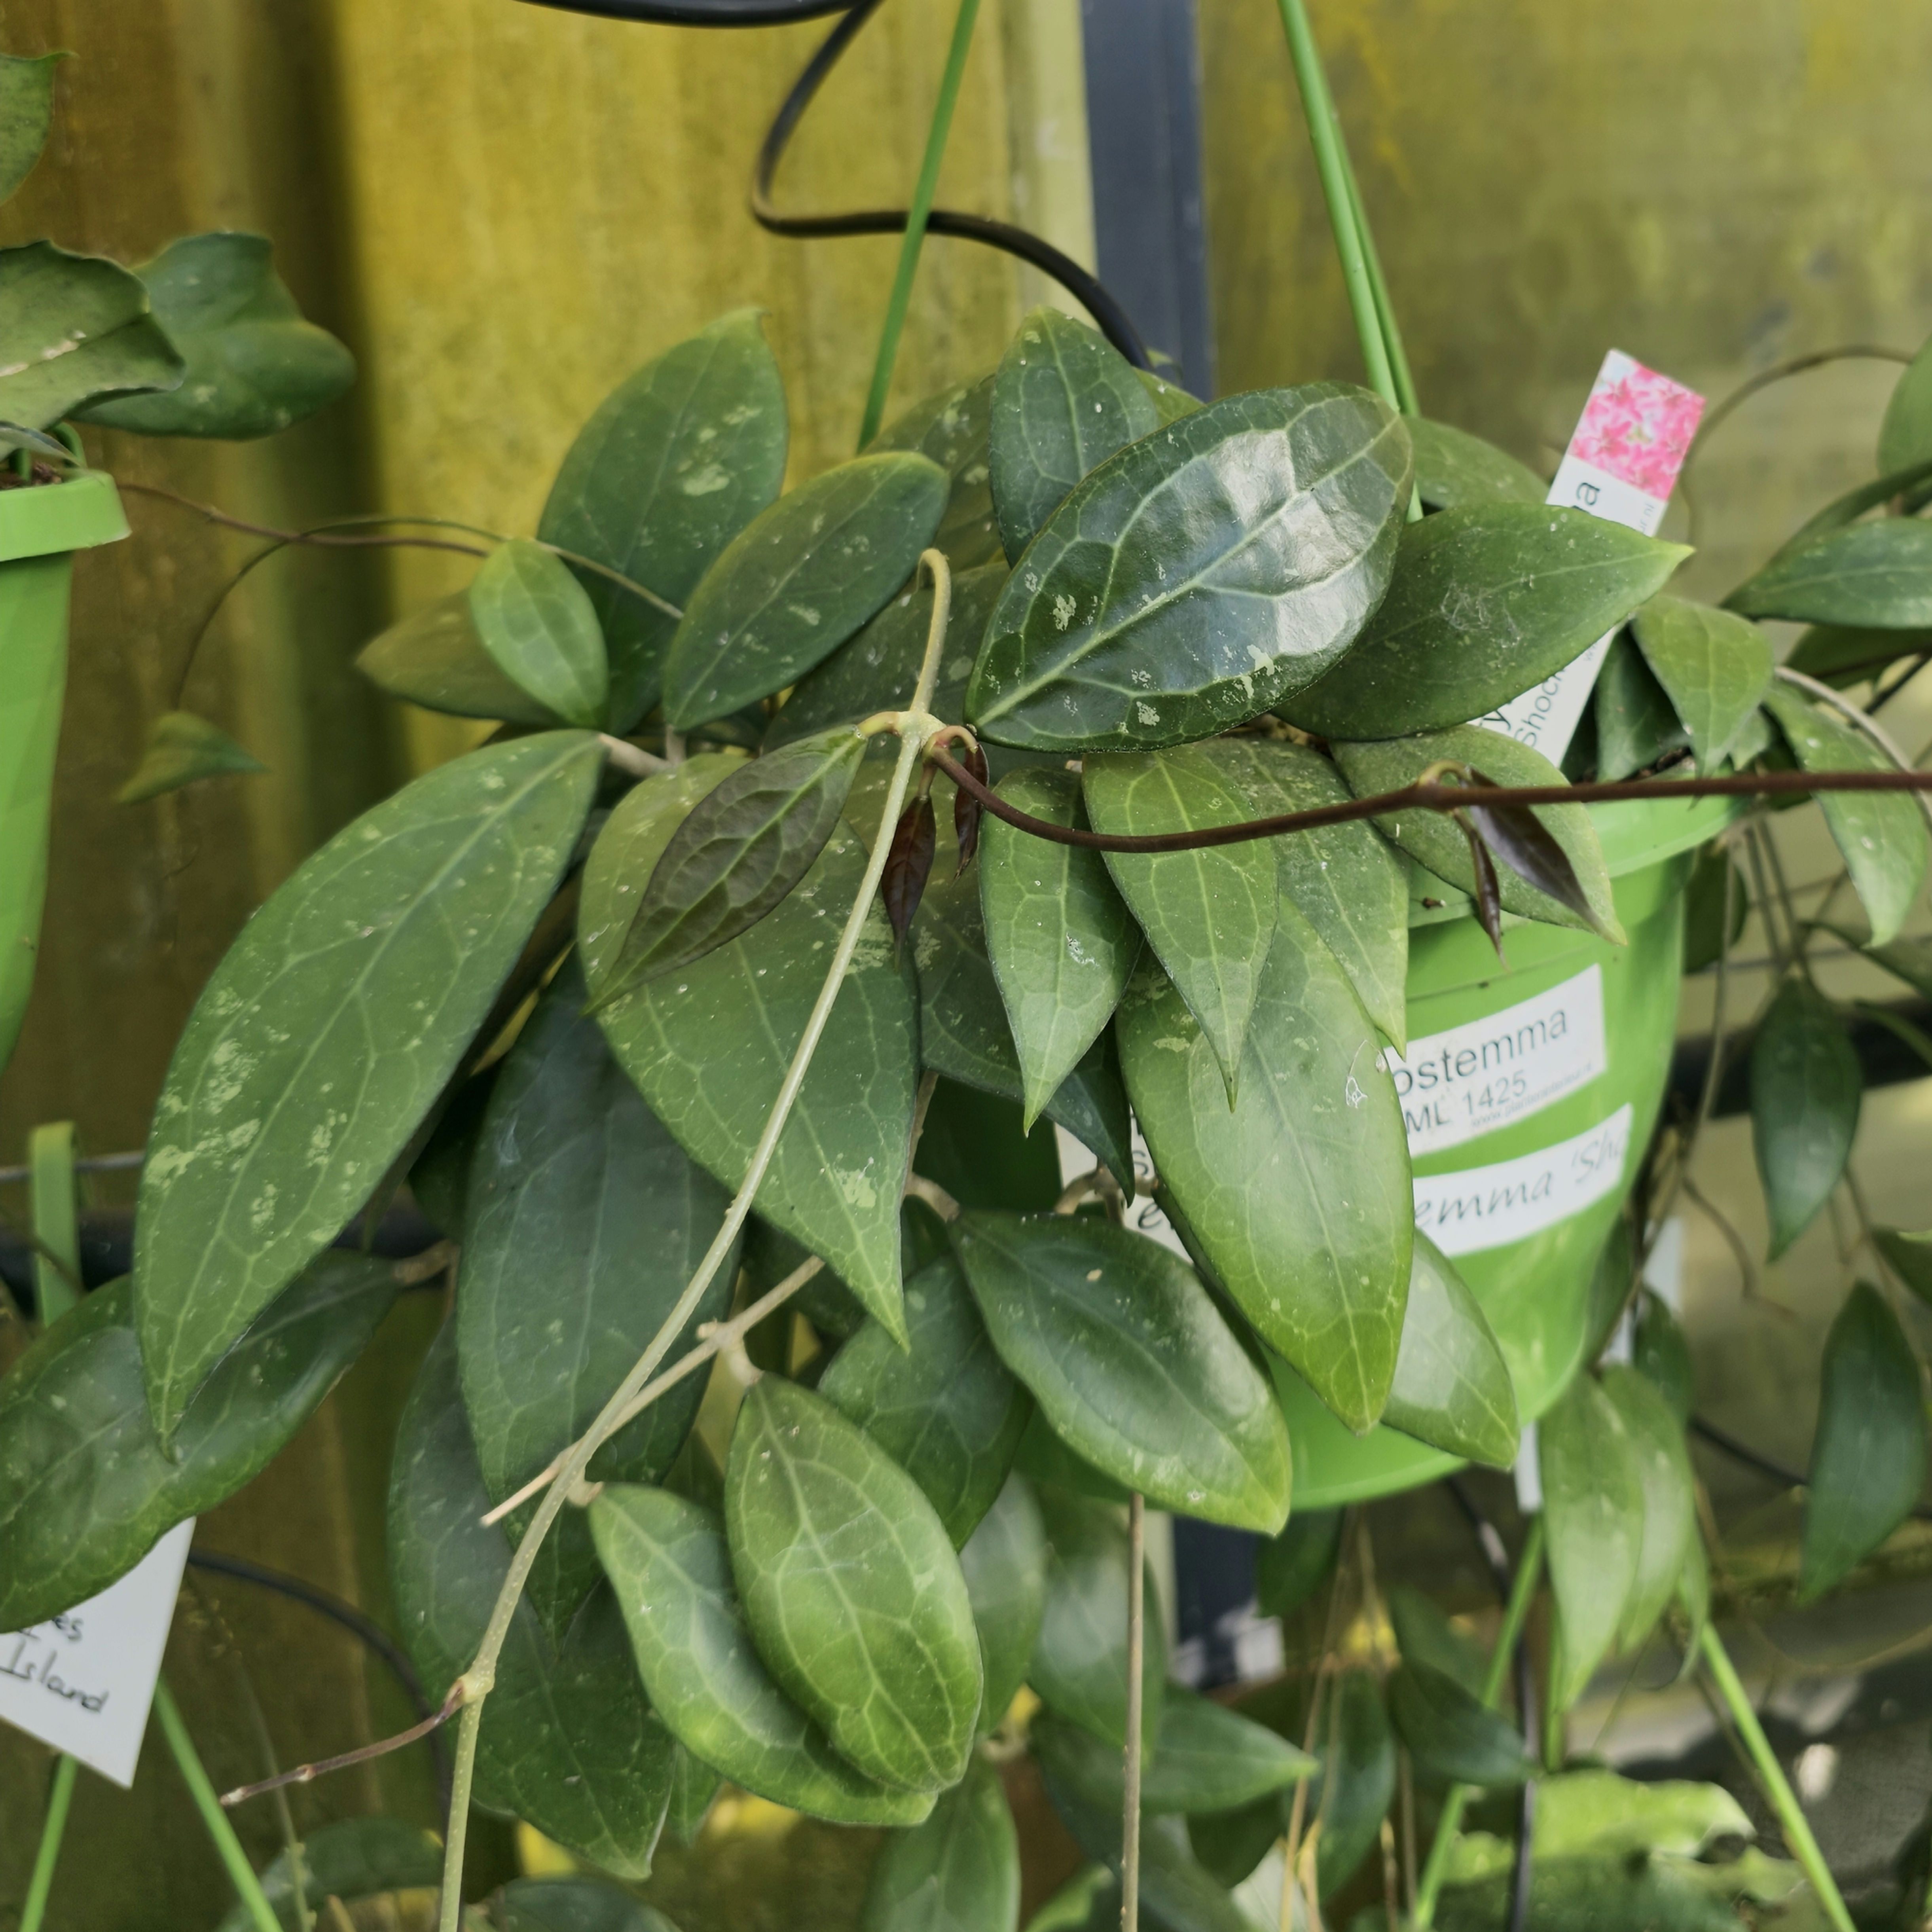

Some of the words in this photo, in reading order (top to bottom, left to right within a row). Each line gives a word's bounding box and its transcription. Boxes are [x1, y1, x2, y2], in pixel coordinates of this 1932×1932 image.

[1393, 1009, 1567, 1096] ostemma
[1406, 1100, 1451, 1135] ML
[1463, 1069, 1526, 1115] 1425
[0, 1637, 109, 1713] Island
